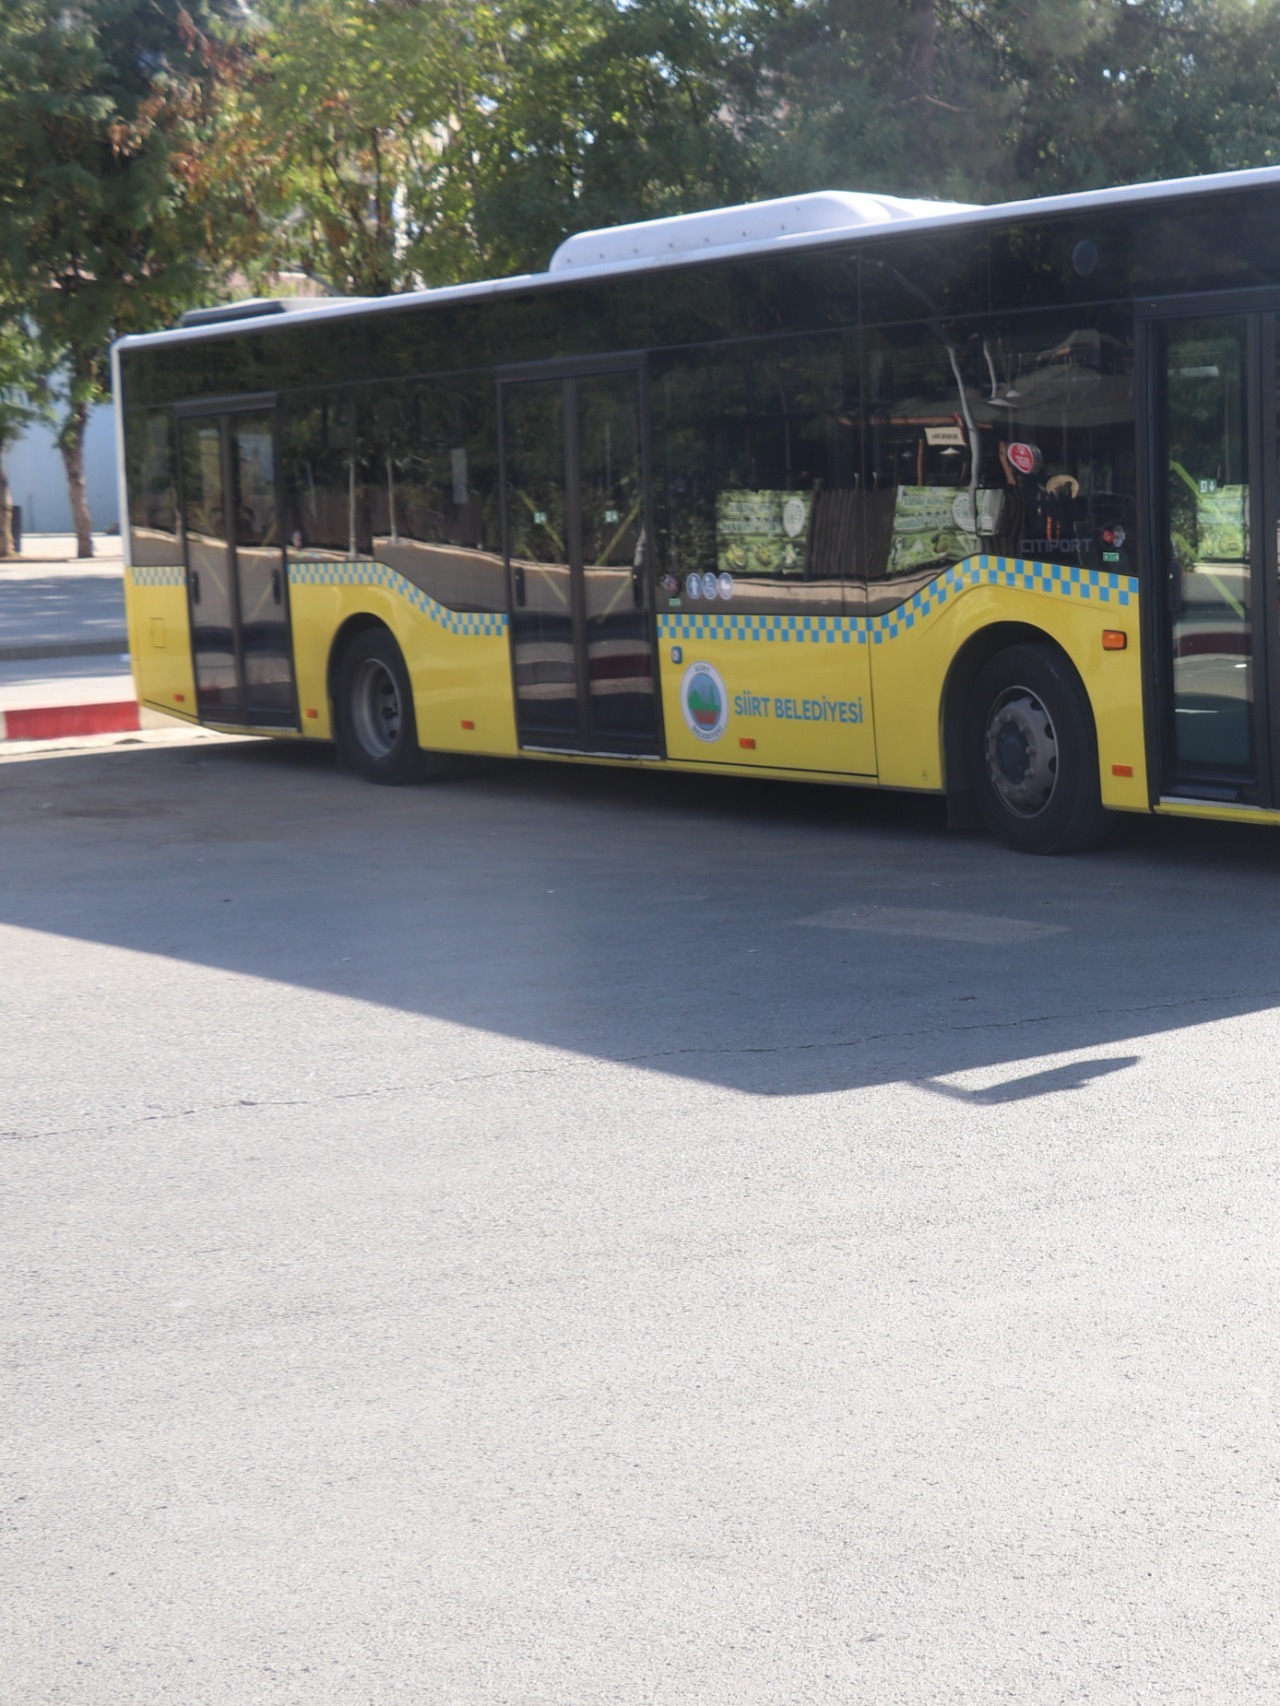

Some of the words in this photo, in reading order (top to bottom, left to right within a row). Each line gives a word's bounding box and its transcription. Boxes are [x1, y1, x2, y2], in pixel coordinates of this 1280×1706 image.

[1020, 538, 1092, 553] CITIPORT
[734, 690, 770, 717] SİİRT
[774, 695, 864, 723] BELEDİYESİ
